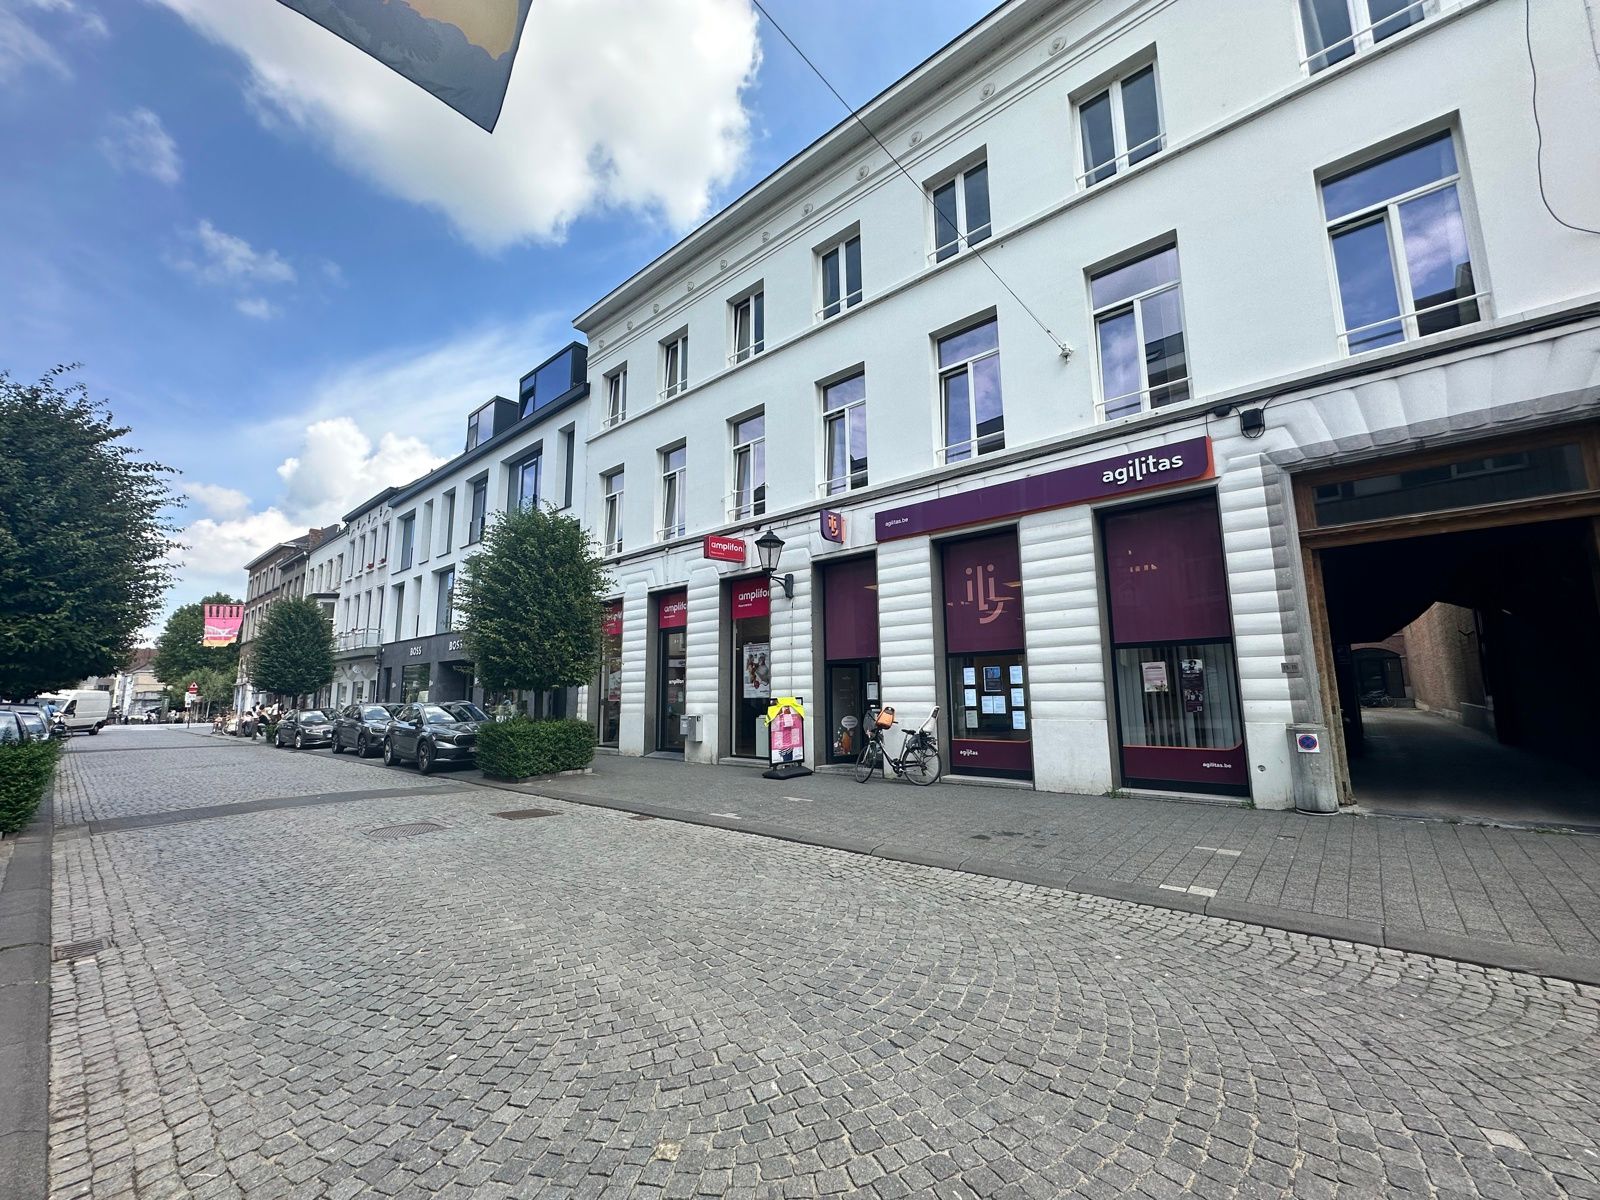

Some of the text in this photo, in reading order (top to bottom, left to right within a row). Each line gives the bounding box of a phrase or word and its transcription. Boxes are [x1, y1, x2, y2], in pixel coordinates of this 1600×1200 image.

[1102, 454, 1184, 485] agilitas
[885, 517, 909, 528] agilitas.be
[710, 541, 743, 552] amplifon
[409, 645, 422, 656] BOSS
